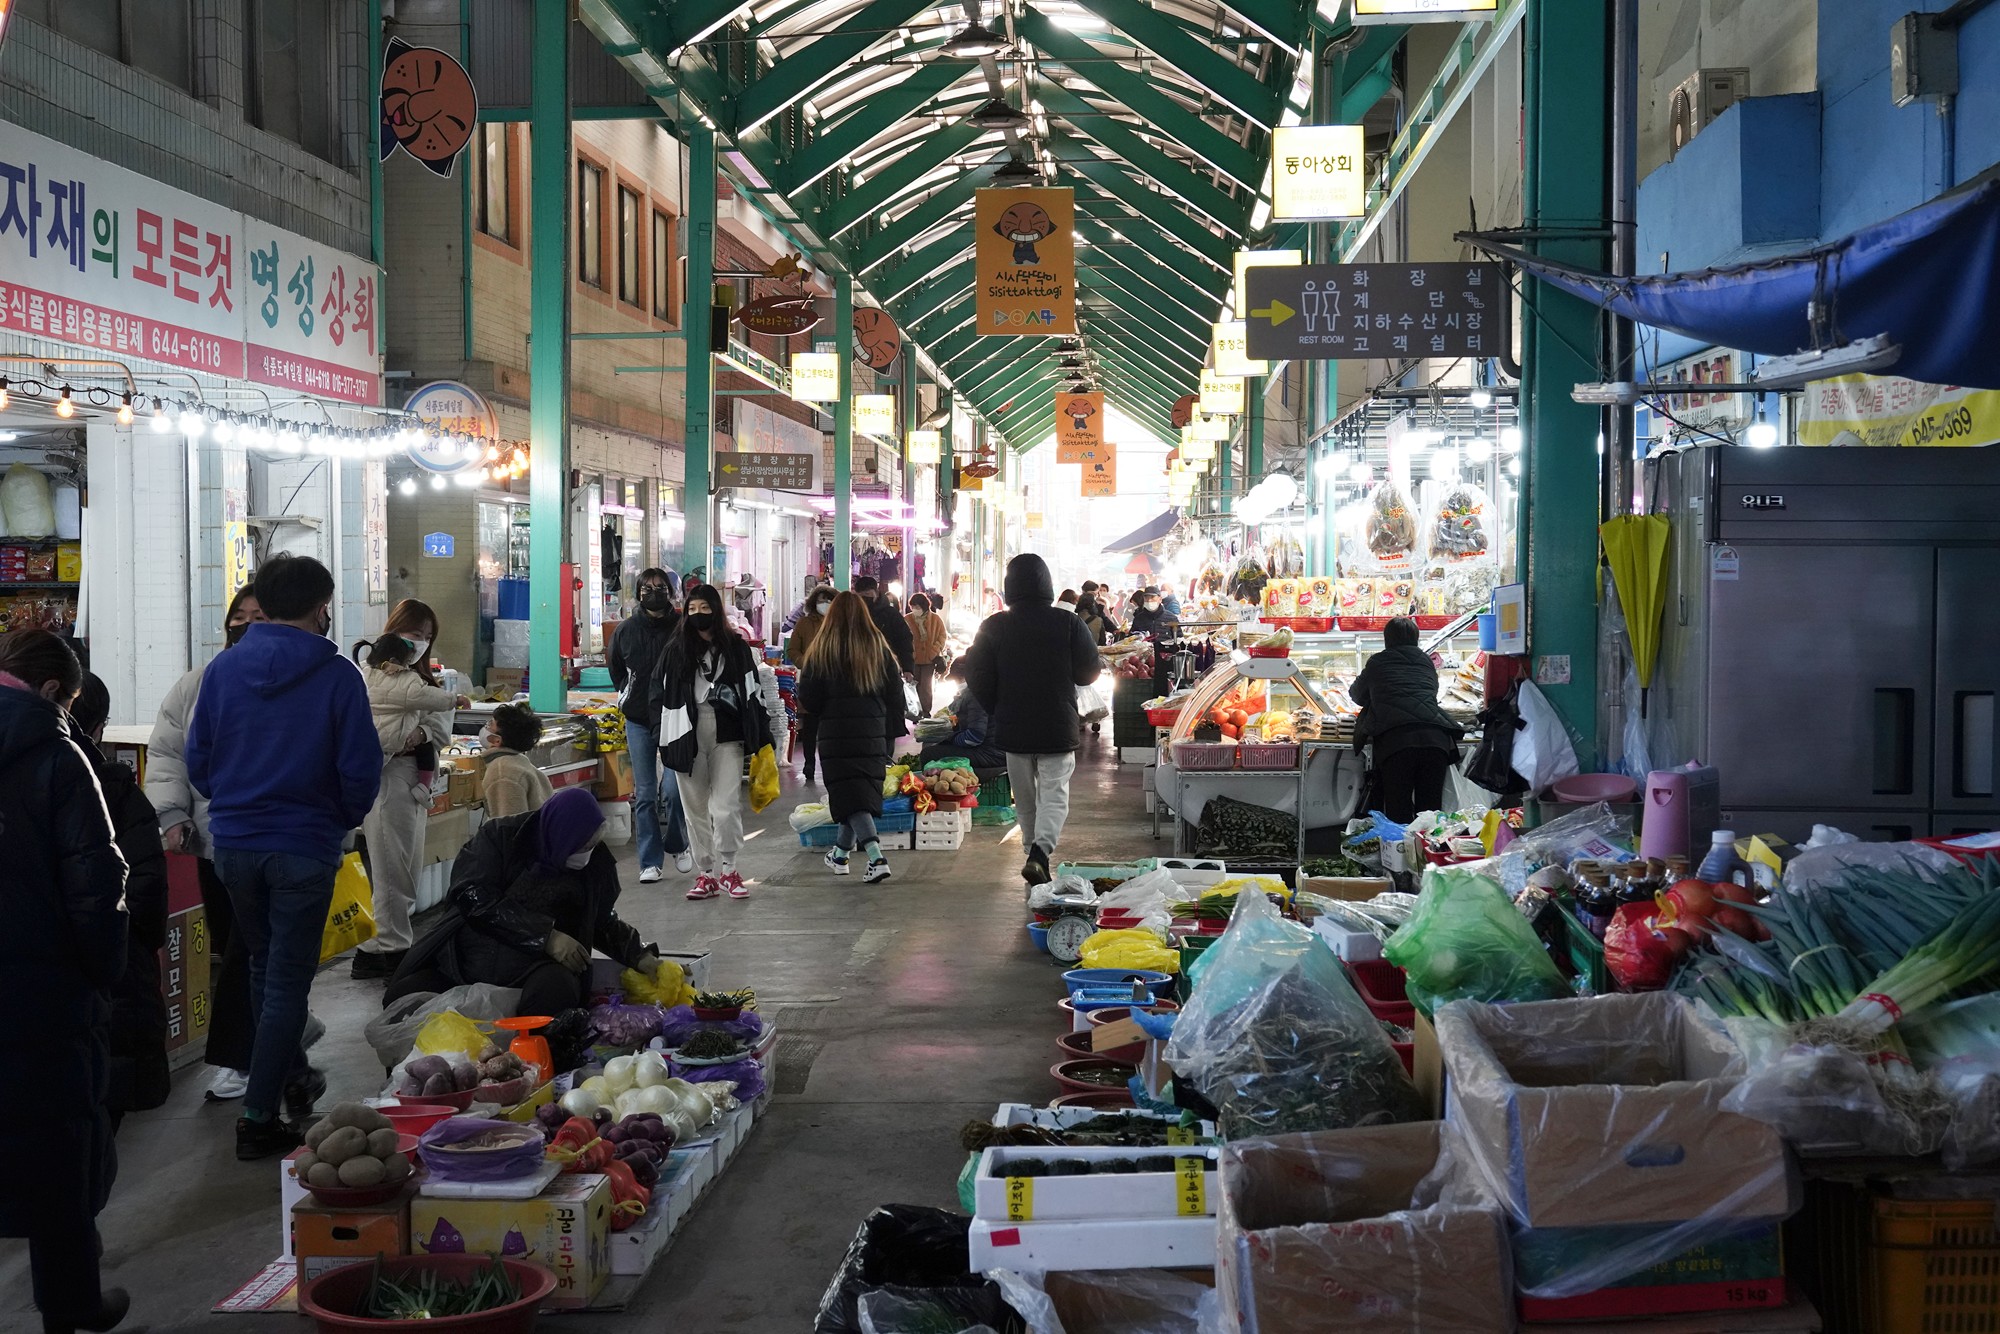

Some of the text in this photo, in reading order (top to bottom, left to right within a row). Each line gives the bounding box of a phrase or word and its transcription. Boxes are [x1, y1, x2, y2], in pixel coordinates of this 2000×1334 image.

[1285, 155, 1352, 175] 동아상회
[132, 207, 233, 313] 모든것
[995, 269, 1057, 285] 시시딱딱이
[250, 239, 374, 357] 명성상회
[989, 286, 1062, 300] Sisittakttagi
[152, 327, 221, 368] 644-6118
[1299, 336, 1345, 345] REST ROOM
[304, 366, 330, 391] 644-6118
[798, 468, 807, 476] 2F
[798, 478, 807, 486] 2F
[431, 544, 447, 555] 24
[191, 917, 206, 1028] 경단
[168, 927, 182, 1039] 찰모듬
[556, 1208, 577, 1290] 꿀고구마
[1727, 1287, 1768, 1303] 15 kg
